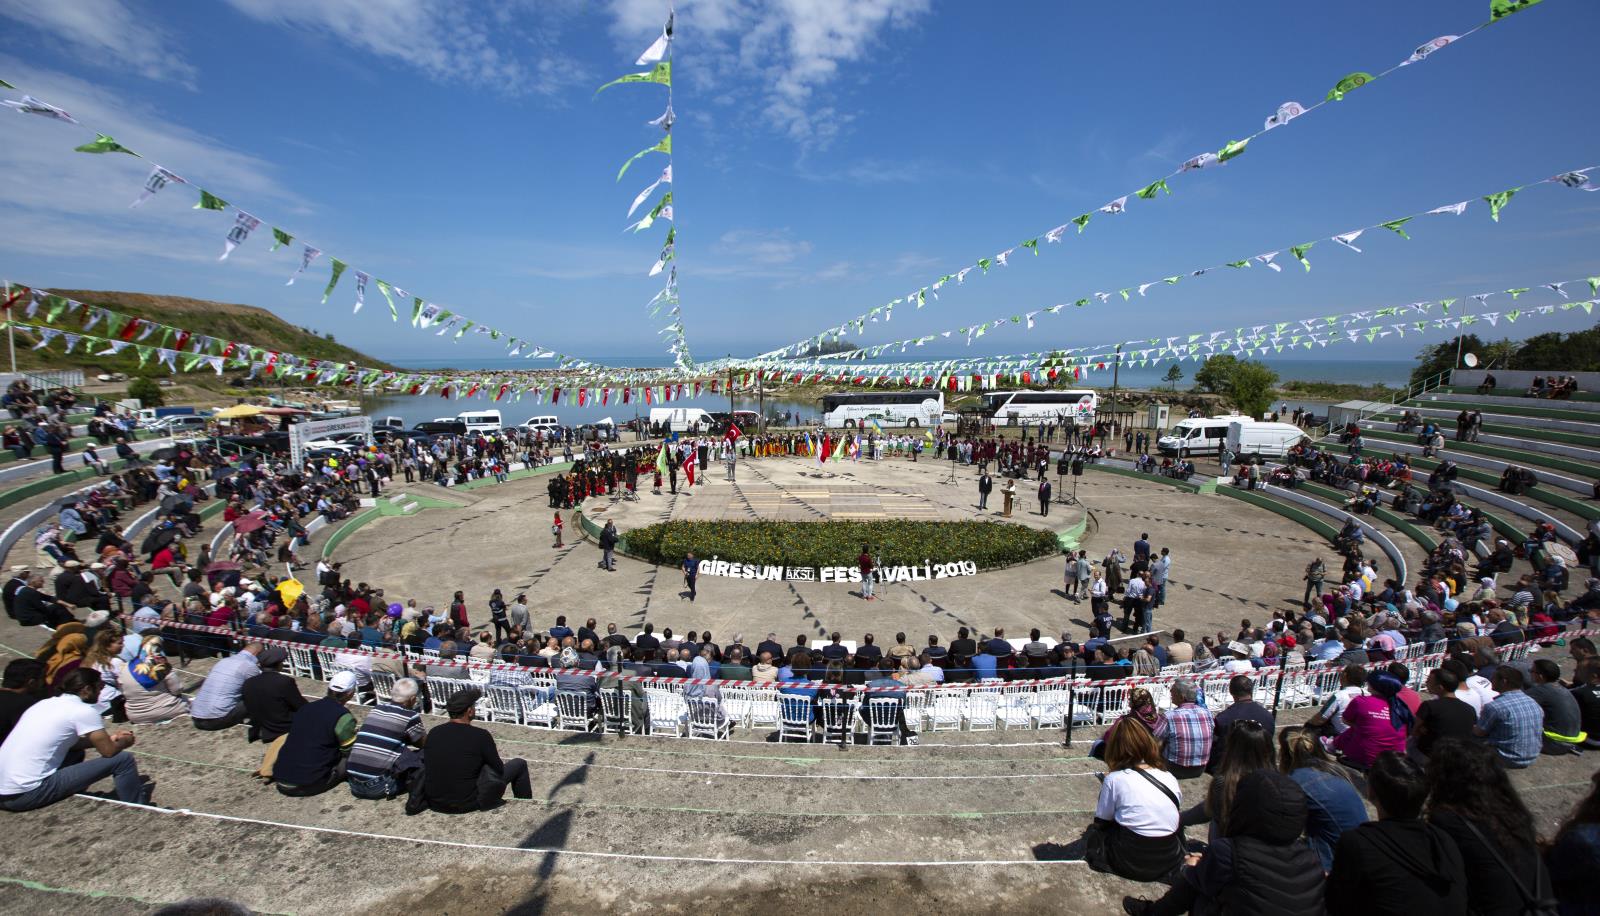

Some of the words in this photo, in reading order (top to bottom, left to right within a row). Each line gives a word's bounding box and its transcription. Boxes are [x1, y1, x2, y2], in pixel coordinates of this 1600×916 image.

[698, 555, 783, 581] GİRESUN
[786, 568, 814, 580] AKSU
[933, 560, 977, 579] 2019
